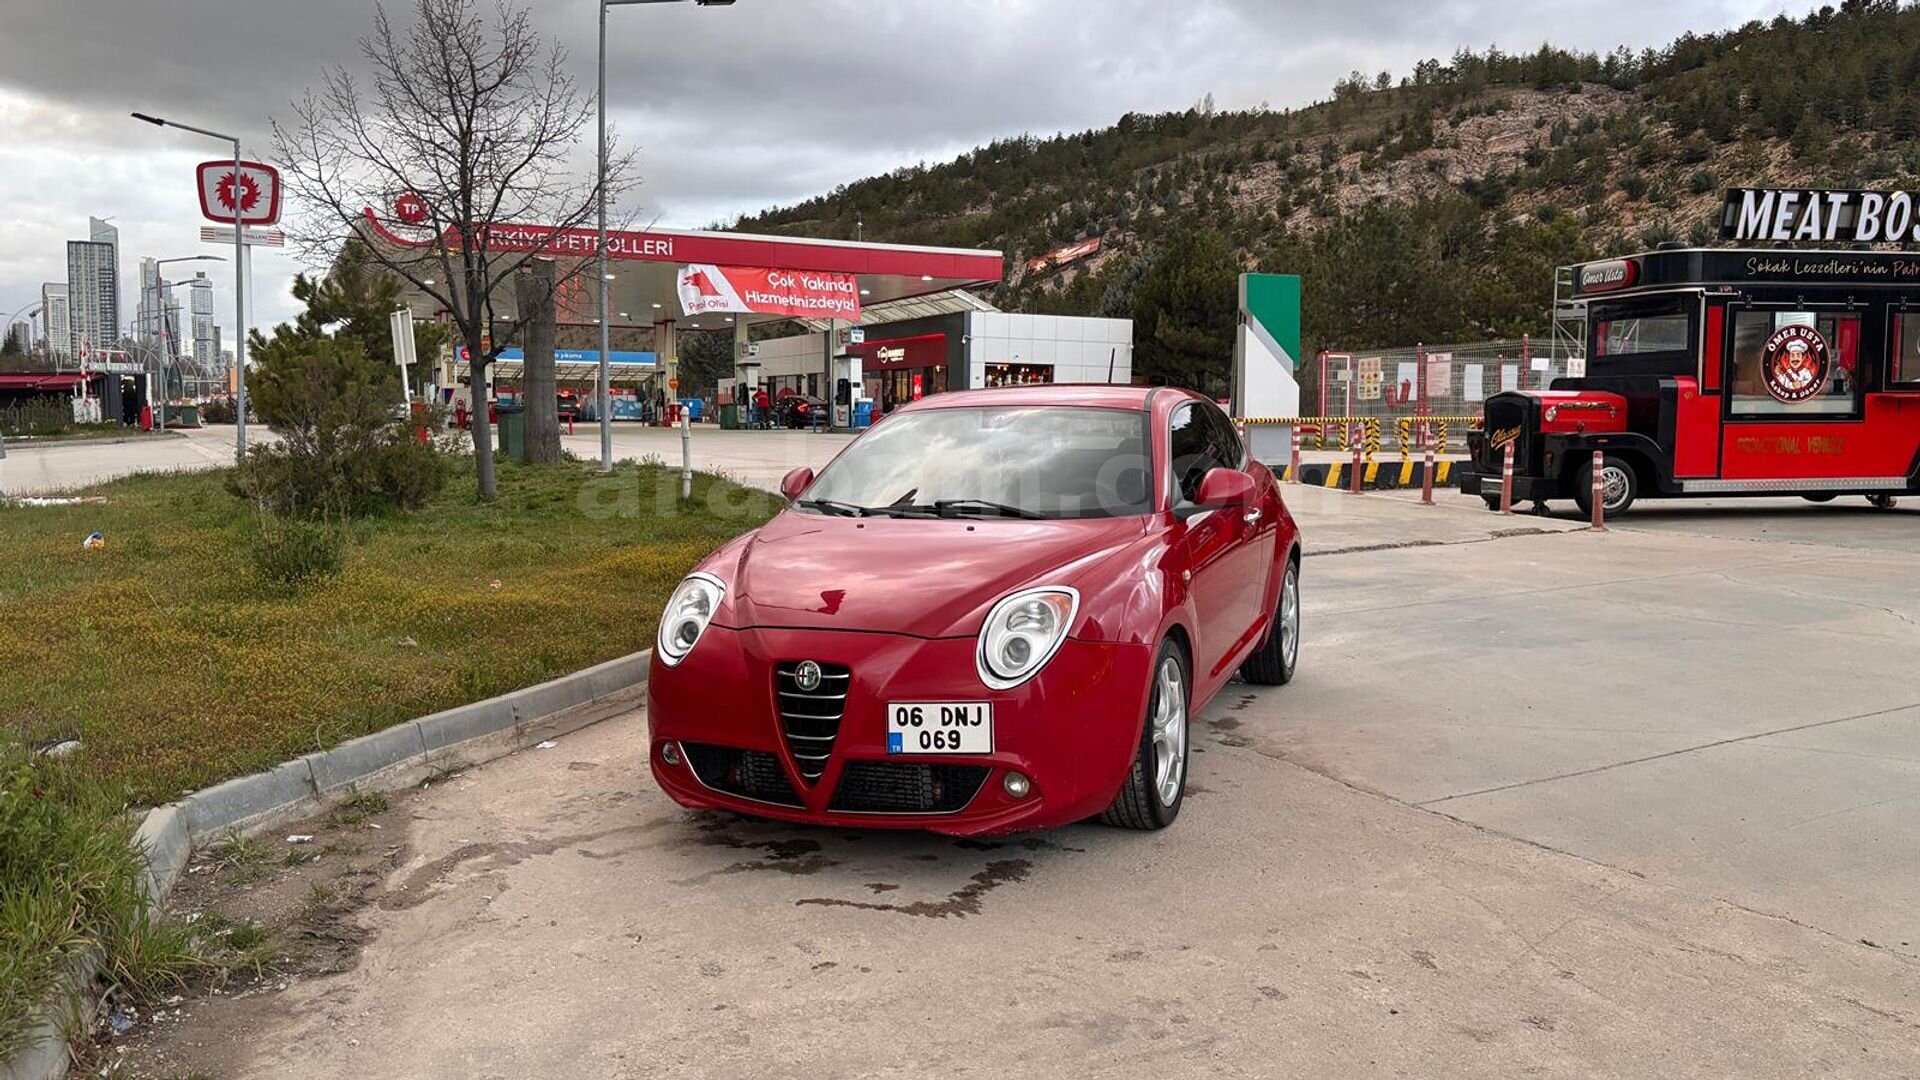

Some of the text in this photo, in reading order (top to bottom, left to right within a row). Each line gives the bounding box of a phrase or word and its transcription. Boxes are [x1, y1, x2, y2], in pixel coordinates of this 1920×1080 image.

[403, 203, 420, 215] TP
[1735, 188, 1920, 242] MEAT BO
[1746, 256, 1790, 275] Sokak
[767, 272, 853, 293] Çok Yakında
[1800, 328, 1824, 352] USTA
[896, 706, 982, 727] 06 DNJ
[919, 730, 961, 750] 069
